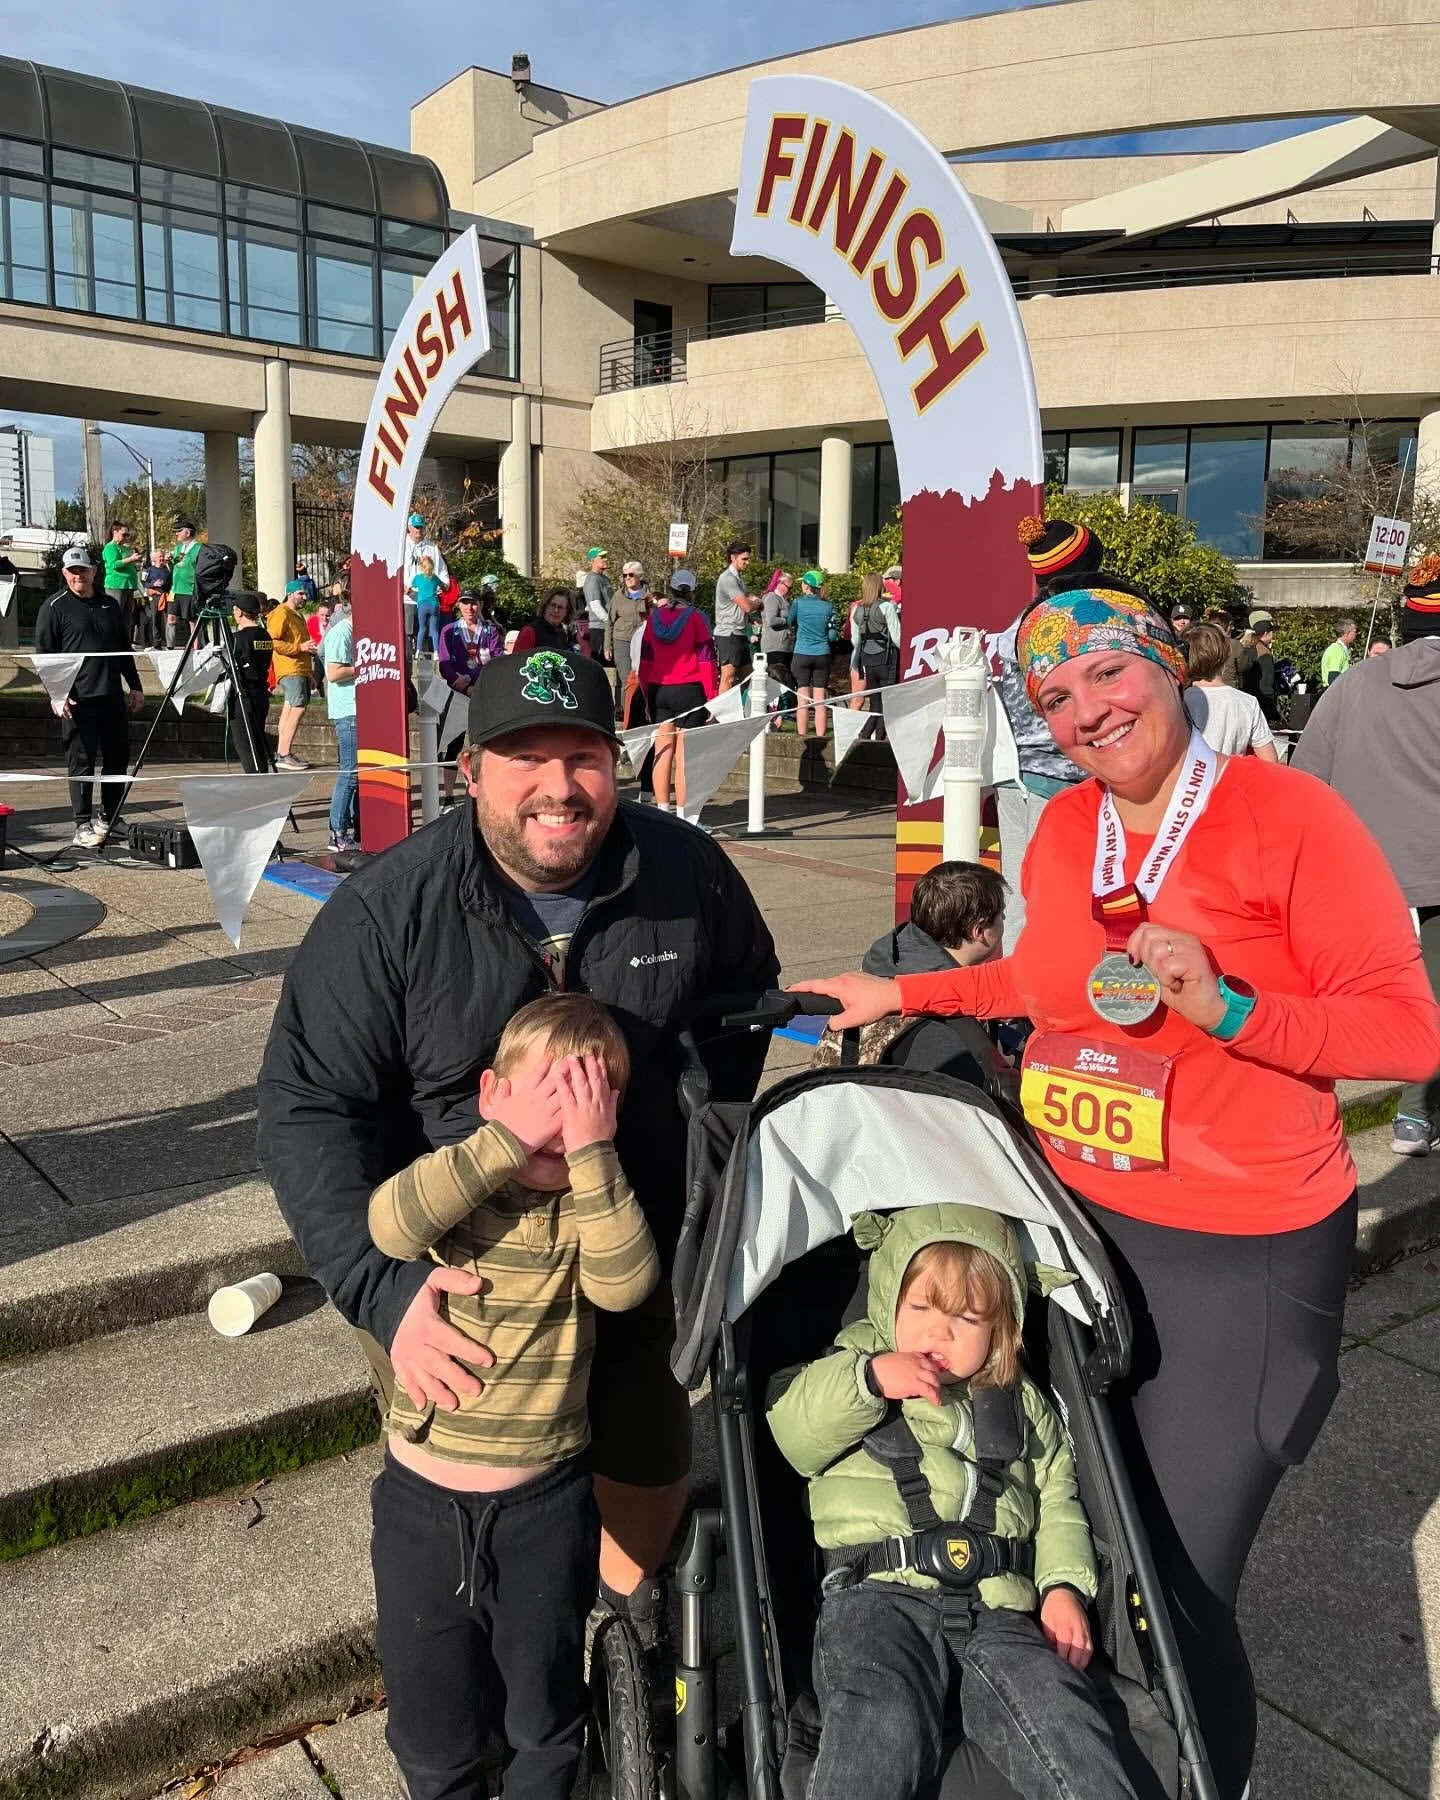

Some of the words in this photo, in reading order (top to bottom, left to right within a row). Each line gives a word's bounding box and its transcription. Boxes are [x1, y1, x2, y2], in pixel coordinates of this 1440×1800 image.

[754, 113, 989, 416] FINISH
[367, 267, 473, 509] FINISH
[1375, 525, 1405, 546] 12:00
[355, 637, 397, 667] Run
[368, 664, 401, 681] Warm
[1189, 759, 1207, 788] RUN
[1181, 787, 1199, 808] TO
[1106, 822, 1117, 851] STAY
[1166, 811, 1189, 842] STAY
[1144, 845, 1173, 884] WARM
[640, 950, 678, 965] Columbia
[1030, 1061, 1049, 1073] 2024
[1076, 1048, 1117, 1065] Run
[1088, 1062, 1120, 1074] Warm
[1140, 1087, 1156, 1099] 10K
[1043, 1083, 1133, 1144] 506
